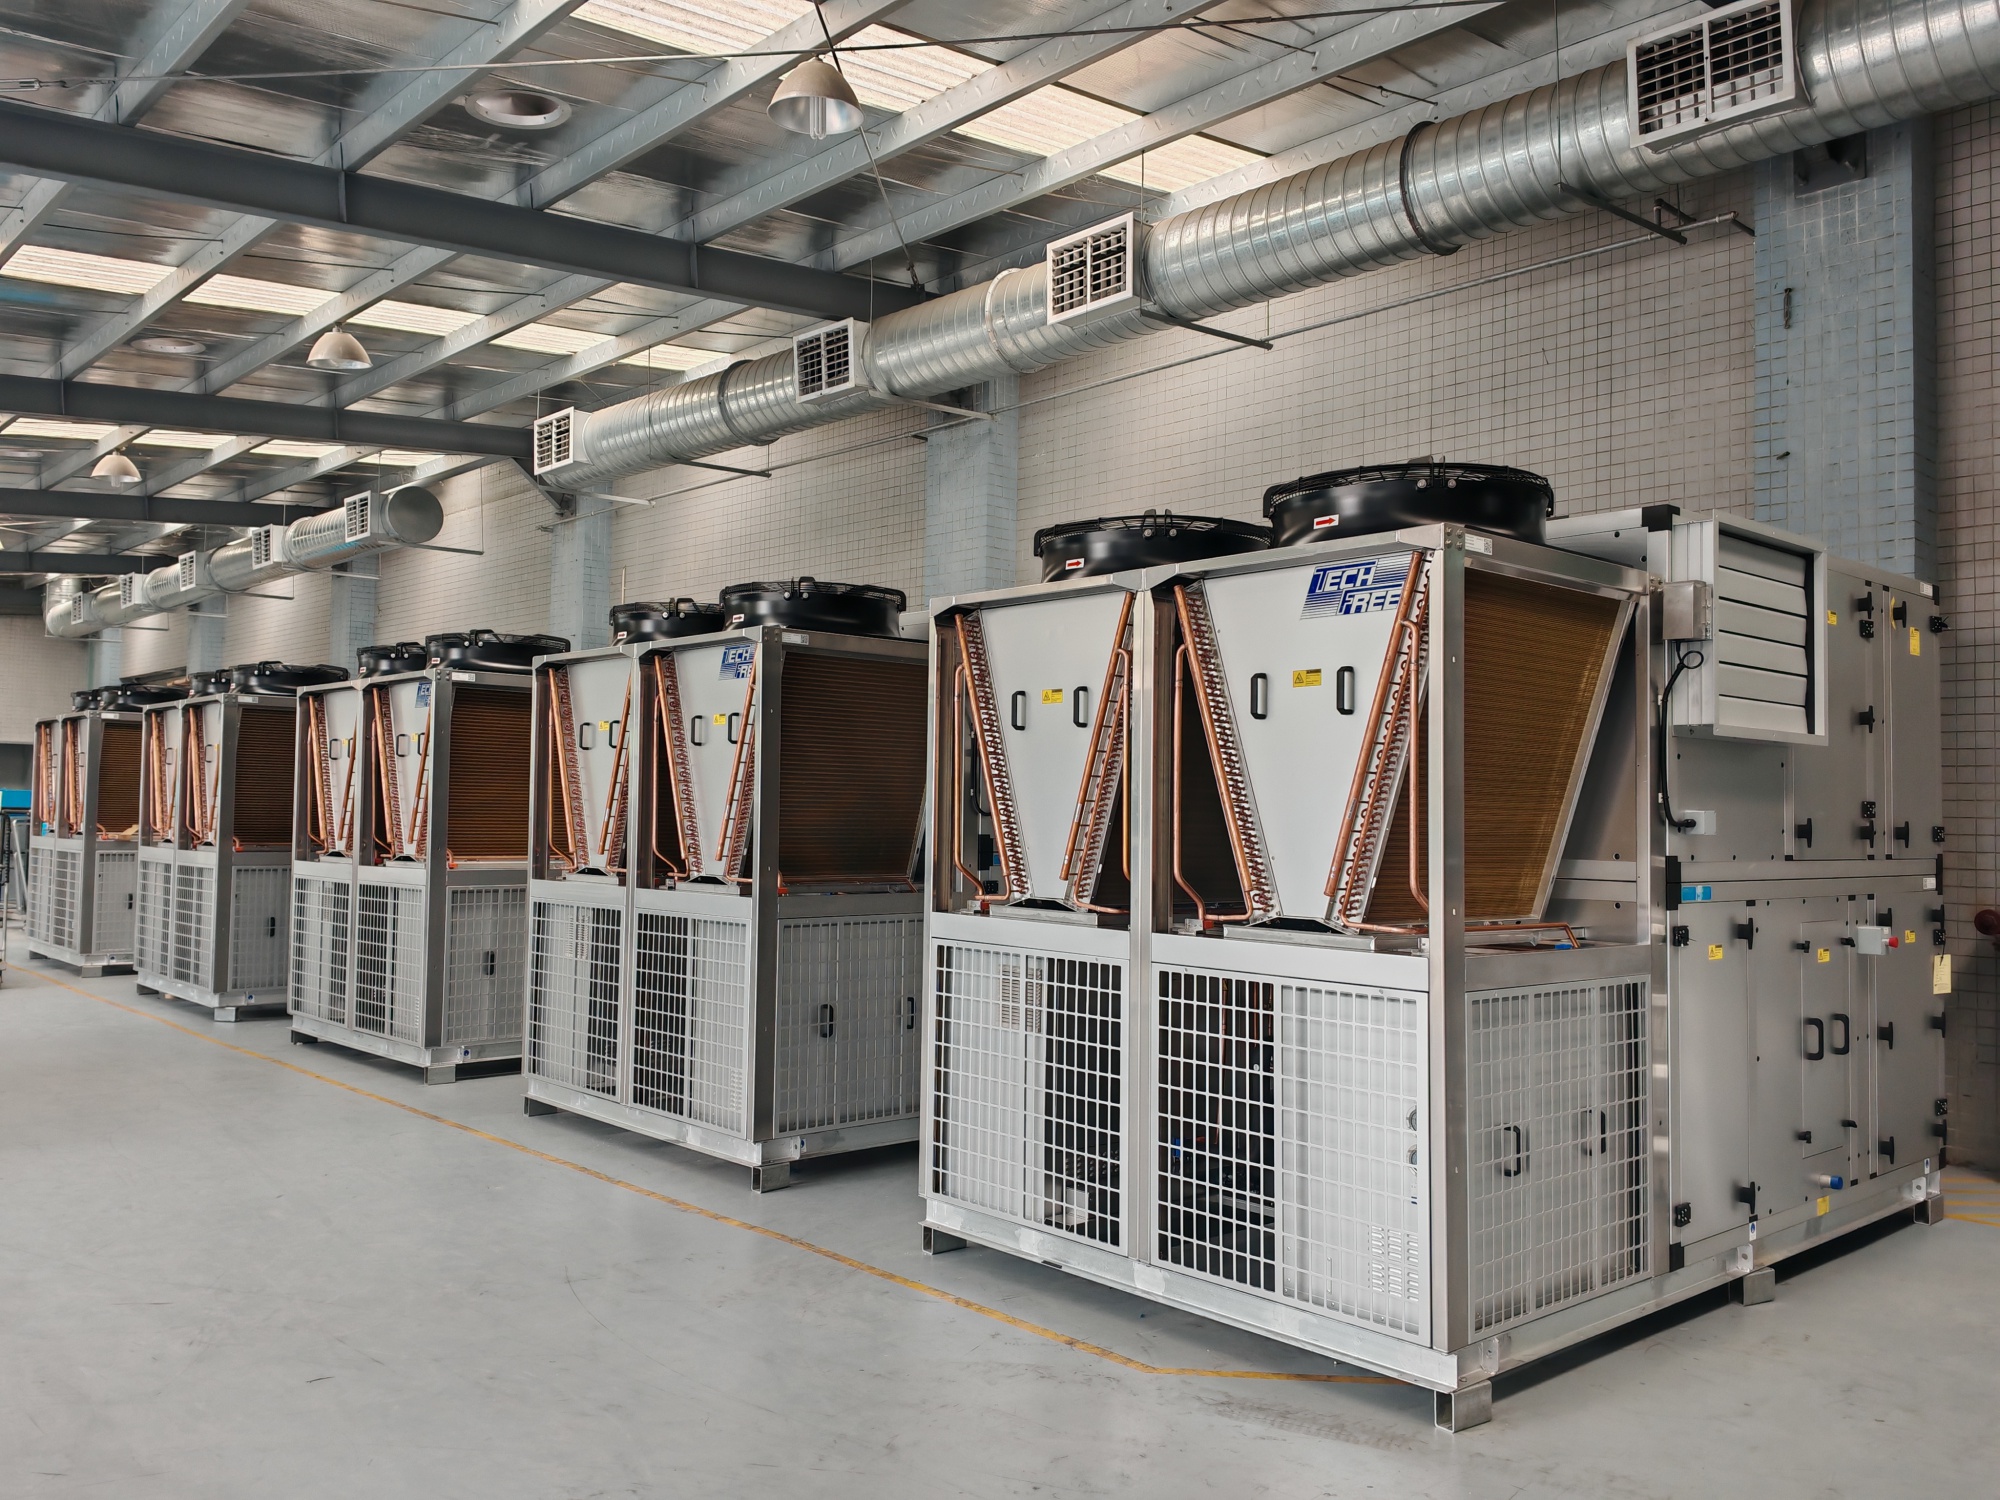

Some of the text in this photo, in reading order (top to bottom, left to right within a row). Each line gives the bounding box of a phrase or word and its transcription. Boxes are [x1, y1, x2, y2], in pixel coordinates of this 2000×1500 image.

[1314, 559, 1378, 592] TECH
[1337, 582, 1403, 615] FREE
[724, 644, 751, 663] TECH
[735, 661, 753, 678] FRE
